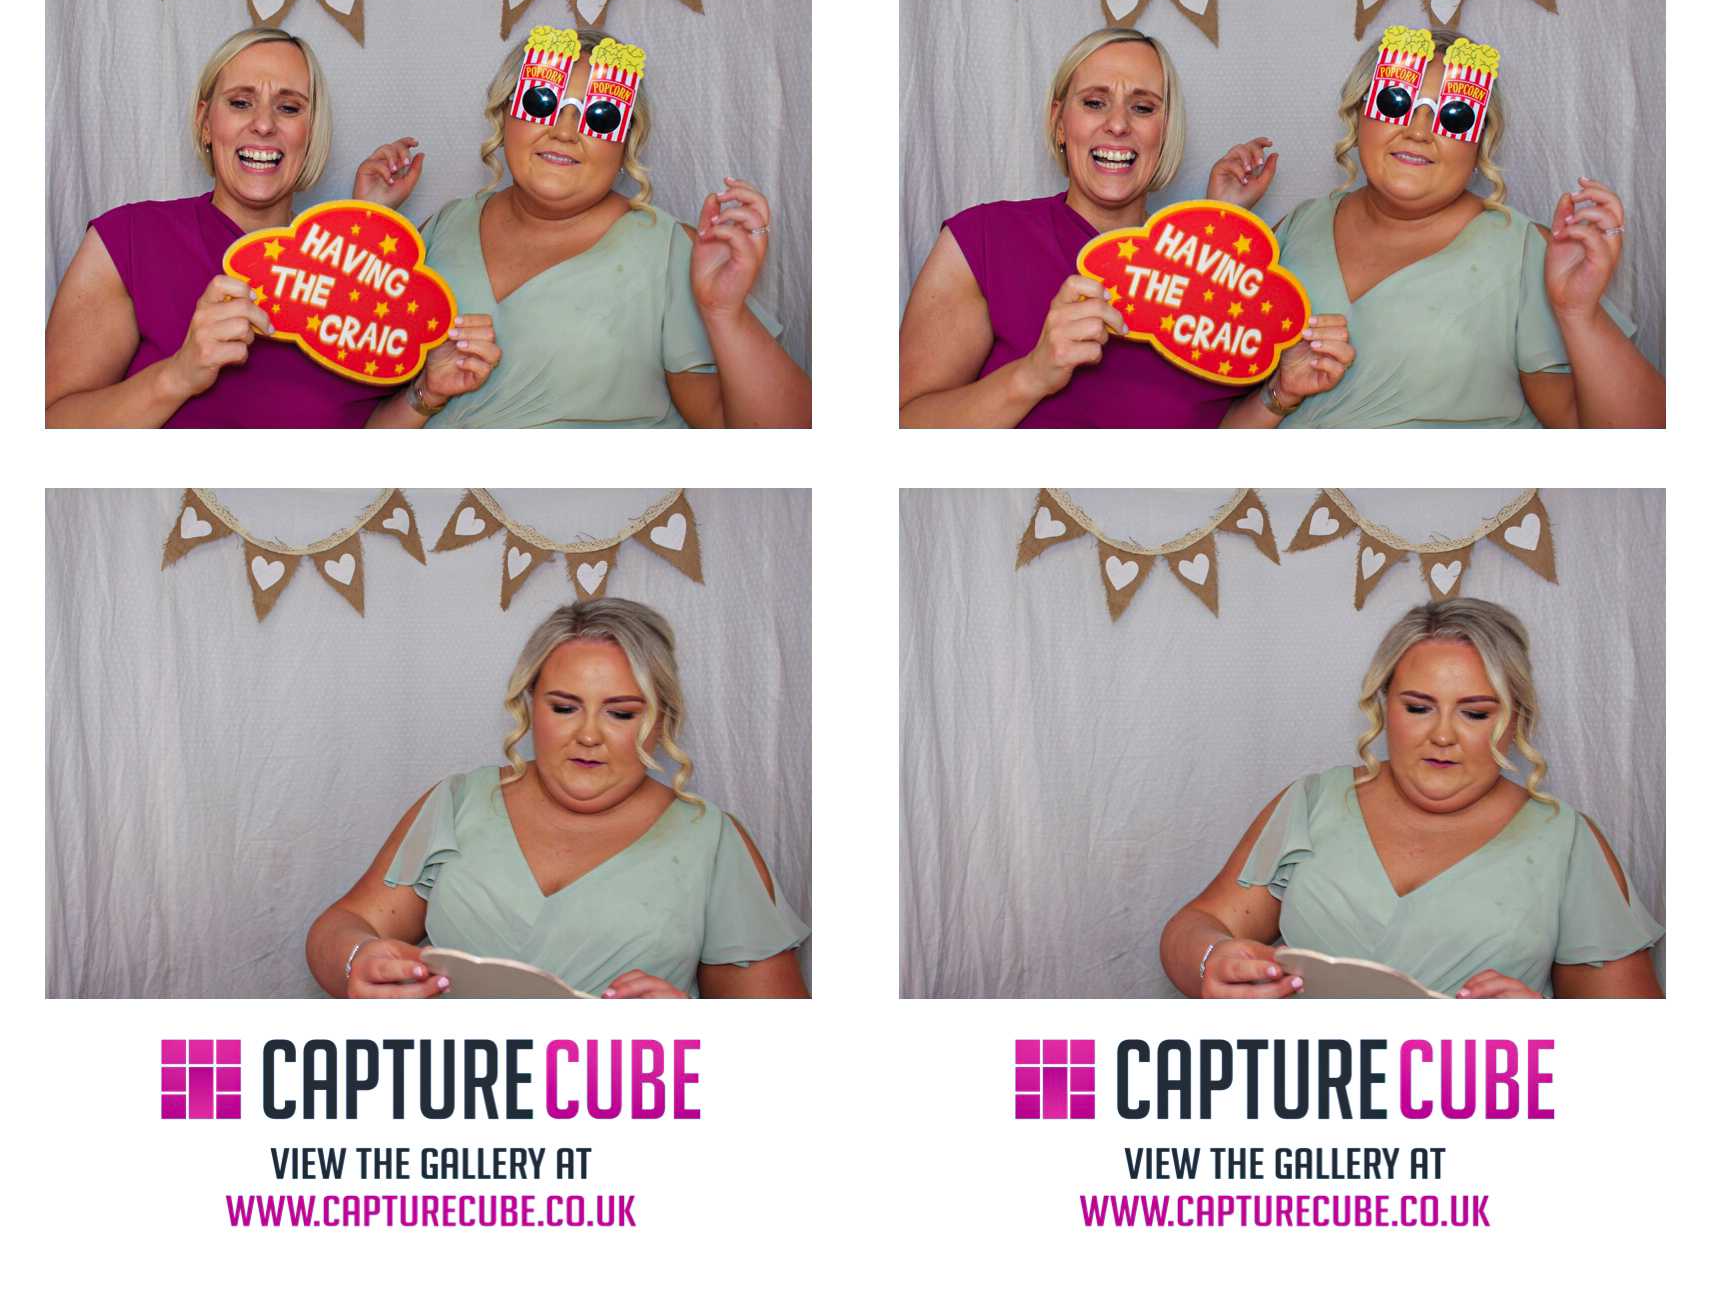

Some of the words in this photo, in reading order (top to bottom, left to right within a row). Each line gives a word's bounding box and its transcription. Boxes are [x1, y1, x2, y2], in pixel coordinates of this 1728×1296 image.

[525, 65, 564, 85] POPCORN
[593, 82, 632, 101] POPCORN
[1379, 65, 1418, 85] POPCORN
[1447, 82, 1486, 101] POPCORN
[300, 223, 410, 297] HAVING
[1154, 223, 1264, 297] HAVING
[271, 265, 336, 308] THE
[1125, 265, 1190, 308] THE
[319, 314, 408, 356] CRAIC
[1173, 314, 1262, 356] CRAIC
